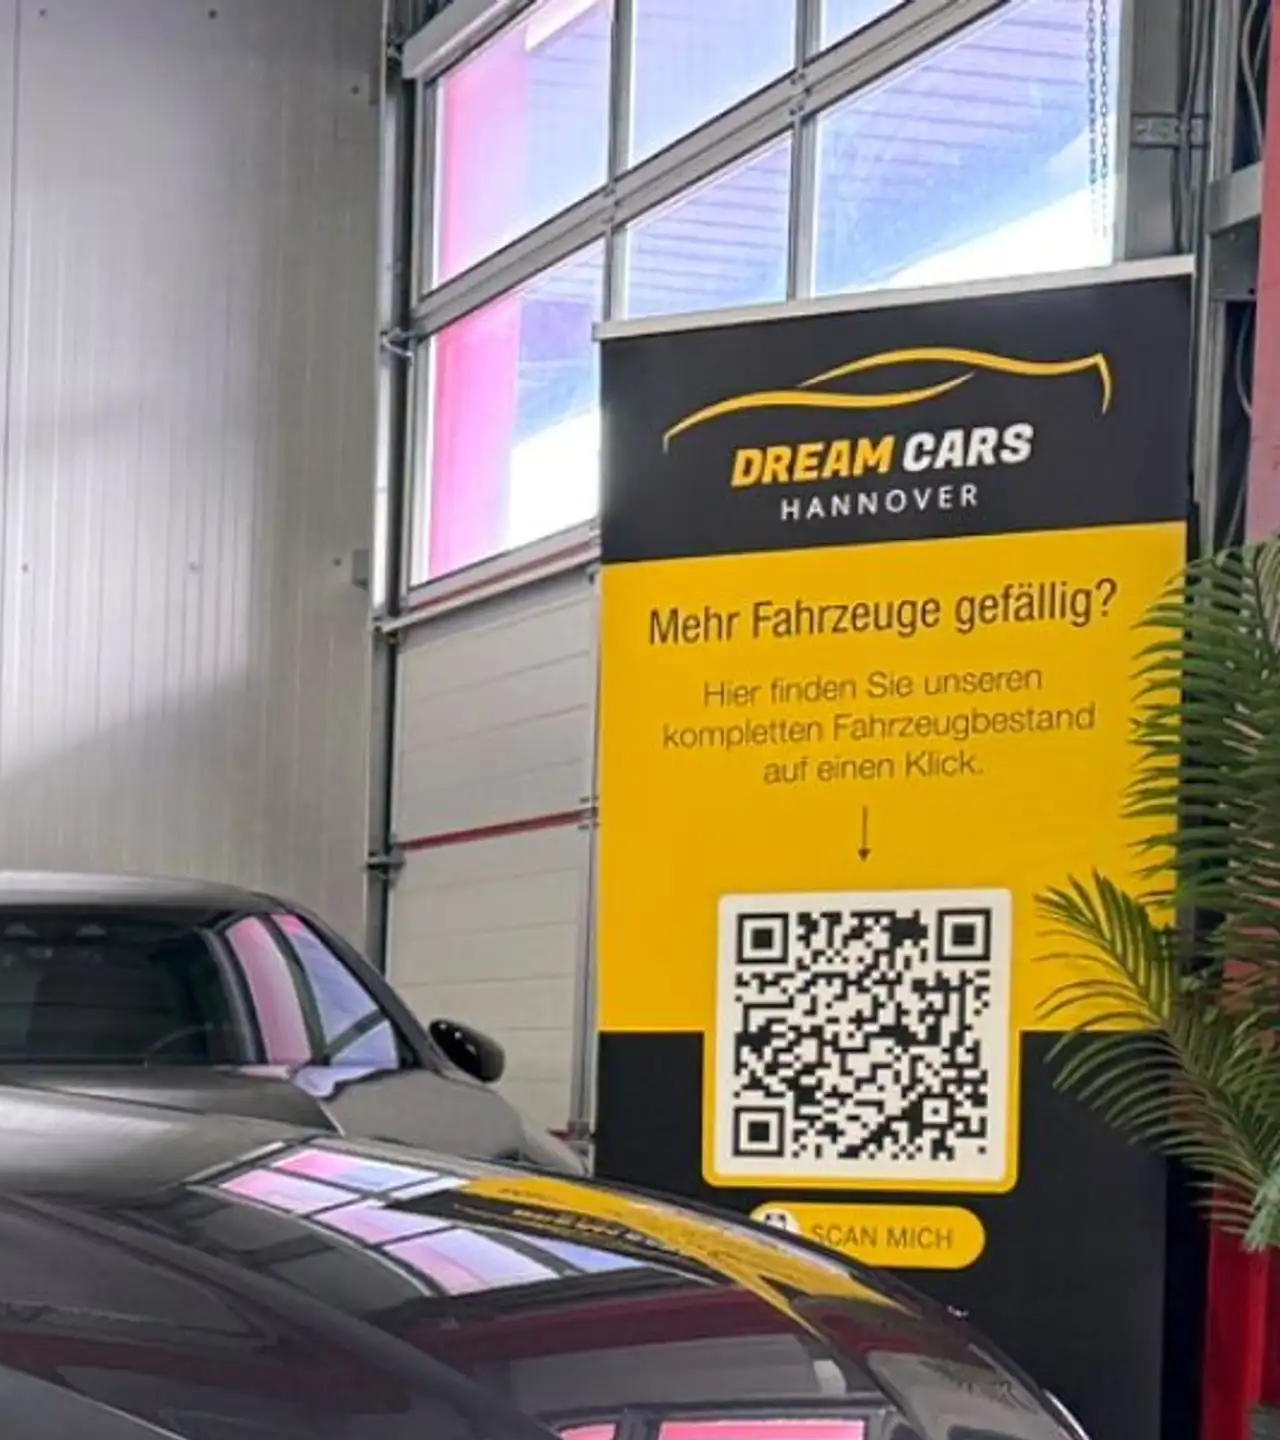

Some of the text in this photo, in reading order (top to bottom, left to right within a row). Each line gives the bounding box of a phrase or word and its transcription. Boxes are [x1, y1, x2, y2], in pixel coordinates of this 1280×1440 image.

[730, 422, 1035, 487] DREAM CARS
[780, 483, 980, 521] HANNOVER
[649, 577, 1118, 645] Mehr Fahrzeuge gefällig?
[703, 667, 1043, 708] Hier finden Sie unseren
[662, 702, 1097, 752] kompletten Fahrzeugbestand
[763, 749, 985, 785] auf einen Klick.
[886, 1226, 954, 1249] MICH
